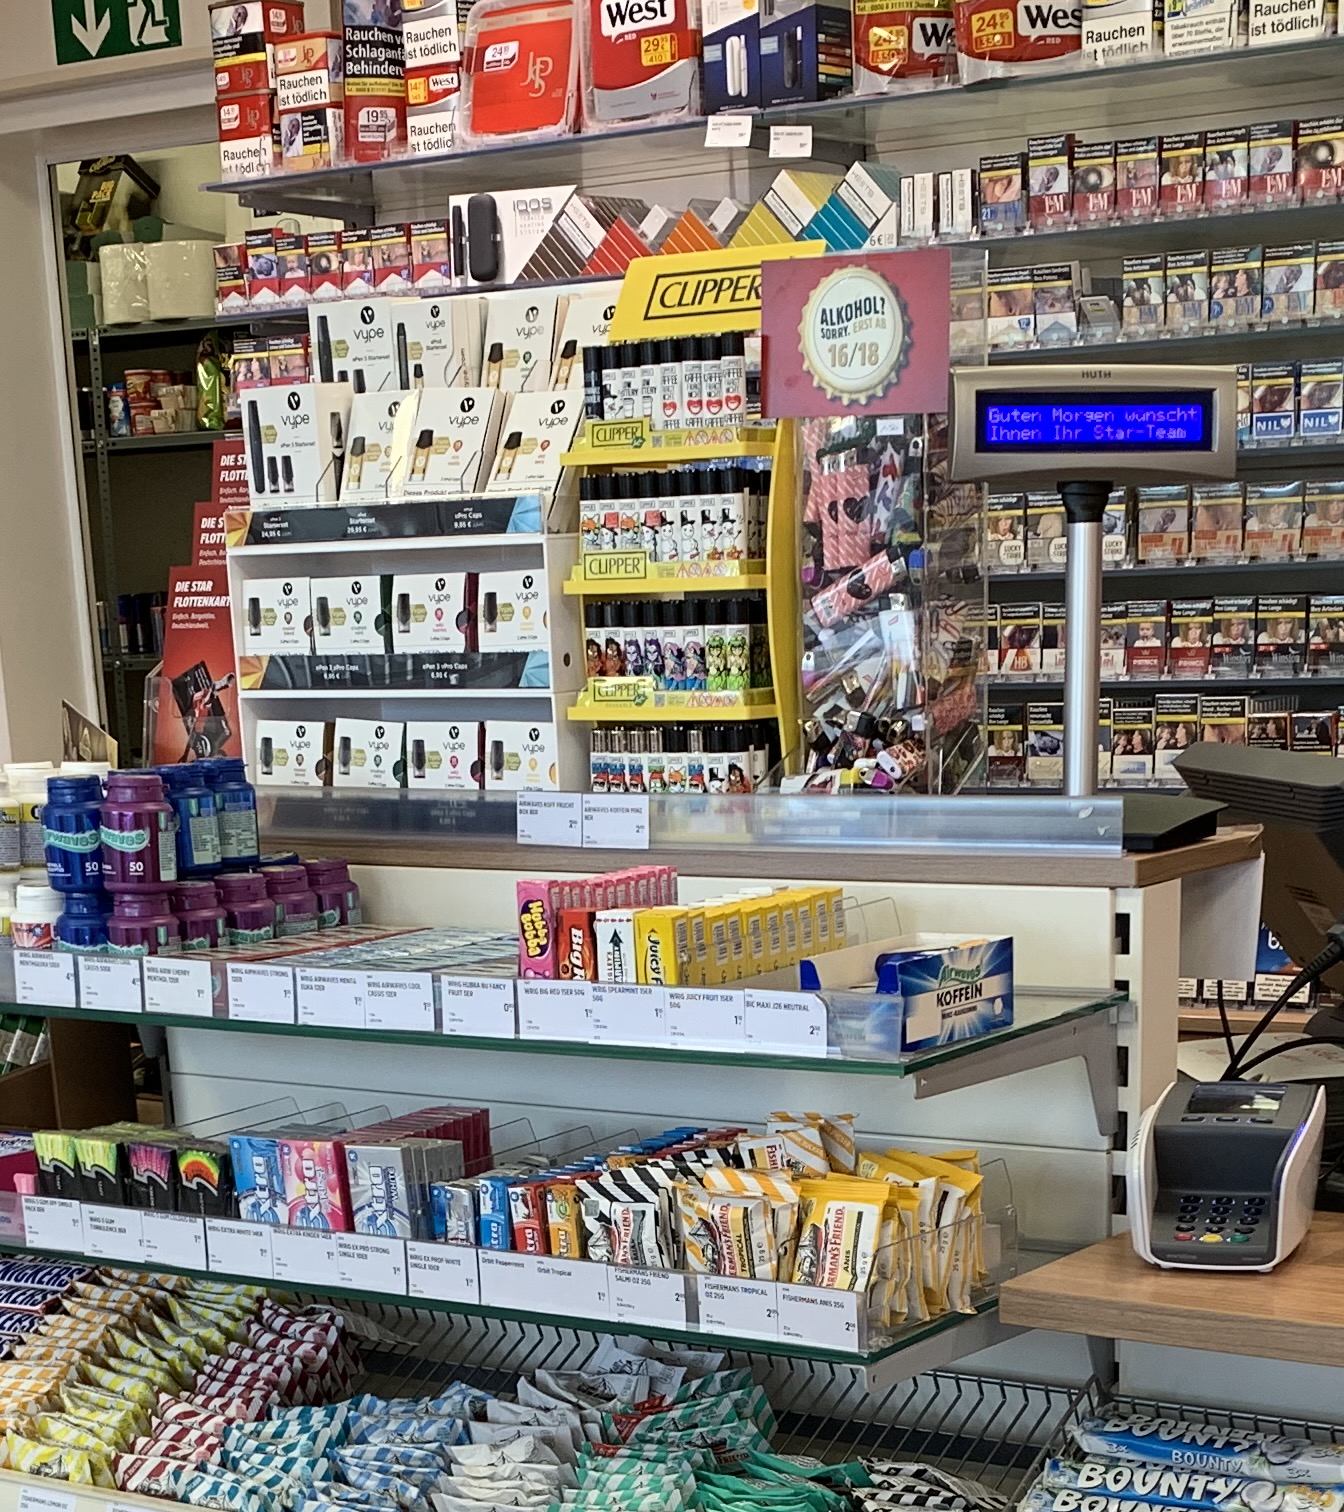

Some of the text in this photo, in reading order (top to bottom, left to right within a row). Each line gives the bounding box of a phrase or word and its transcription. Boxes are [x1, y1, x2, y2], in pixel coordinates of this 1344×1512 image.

[606, 0, 668, 27] West
[1254, 0, 1316, 16] Rauchen
[1085, 23, 1145, 44] Rauchen
[1251, 14, 1319, 37] ist tödlich
[407, 28, 451, 43] Rauchen
[419, 40, 456, 58] tödlich
[280, 75, 322, 90] Rauchen
[431, 75, 454, 87] West
[280, 90, 327, 106] ist tödlich
[869, 234, 883, 245] 6 €
[659, 274, 762, 309] CLIPPER
[820, 297, 885, 326] ALKOHOL?
[354, 327, 384, 342] vype
[516, 325, 544, 339] vype
[853, 319, 873, 334] ERST
[875, 318, 886, 329] AB
[828, 342, 879, 368] 16/18
[1081, 369, 1112, 380] HUTH
[988, 406, 1201, 425] Guten Morgen wünscht
[596, 426, 639, 443] CLIPPER
[989, 425, 1187, 441] Ihnen Ihr Star-Team
[1254, 416, 1282, 437] NIL
[589, 557, 641, 575] CLIPPER
[85, 862, 99, 872] 50
[938, 960, 983, 982] Airwaves
[936, 982, 983, 1006] KOFFEIN
[736, 1234, 746, 1272] TROPICAL
[843, 1249, 852, 1271] ANIS
[738, 1287, 768, 1296] TROPICAL
[782, 1293, 818, 1305] FISHERMANS
[1077, 1463, 1244, 1503] BOUNTY
